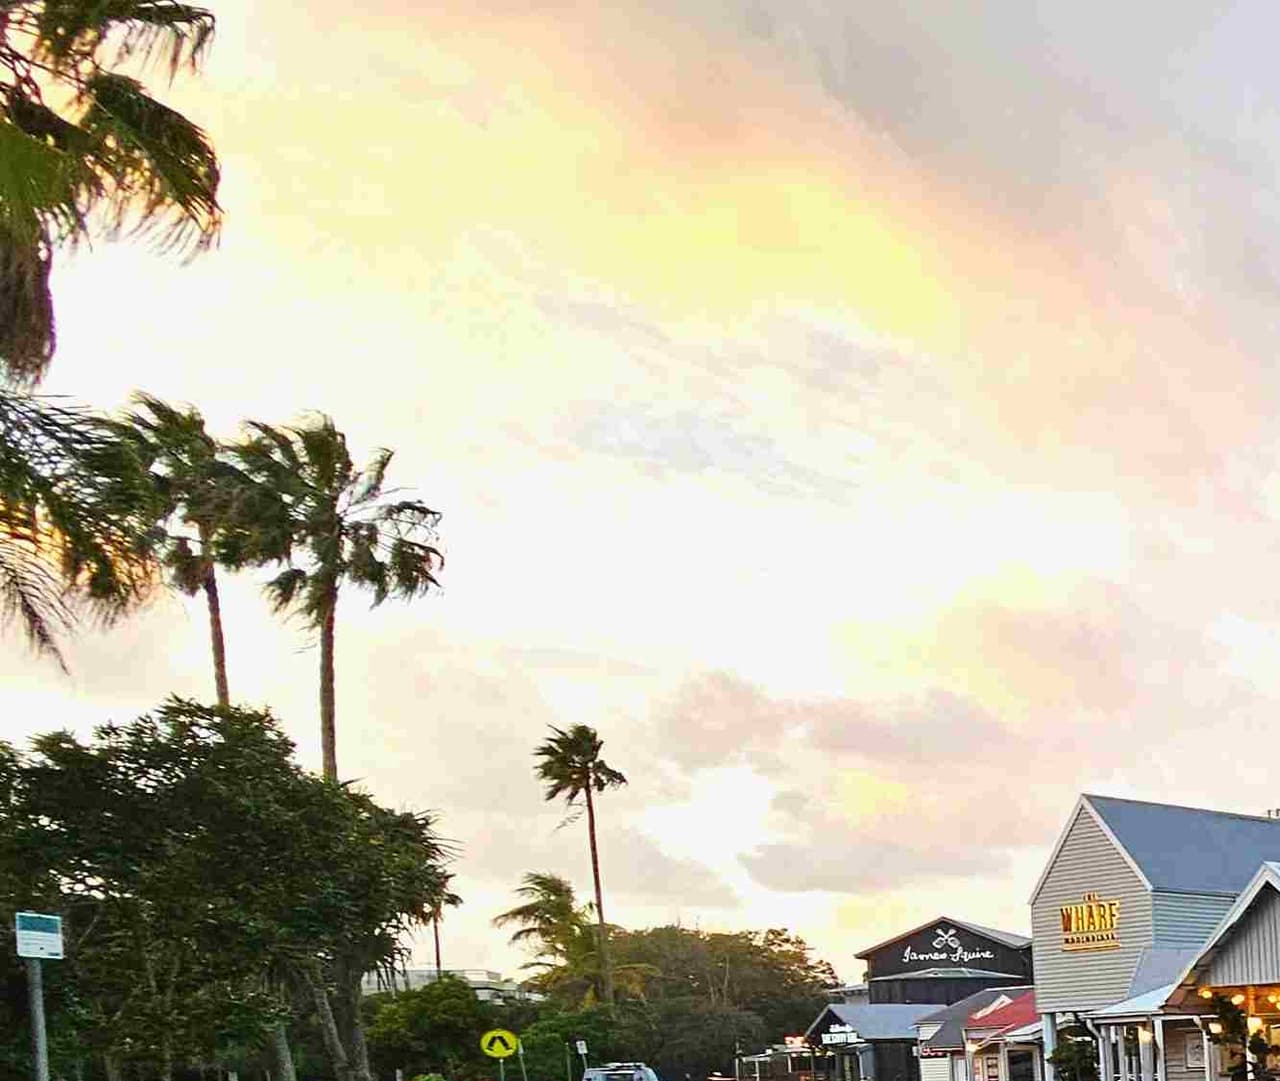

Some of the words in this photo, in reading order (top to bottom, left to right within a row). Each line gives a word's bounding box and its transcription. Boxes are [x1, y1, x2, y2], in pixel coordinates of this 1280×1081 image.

[1060, 902, 1117, 932] WHARF
[902, 945, 948, 962] James
[950, 946, 994, 962] Squire
